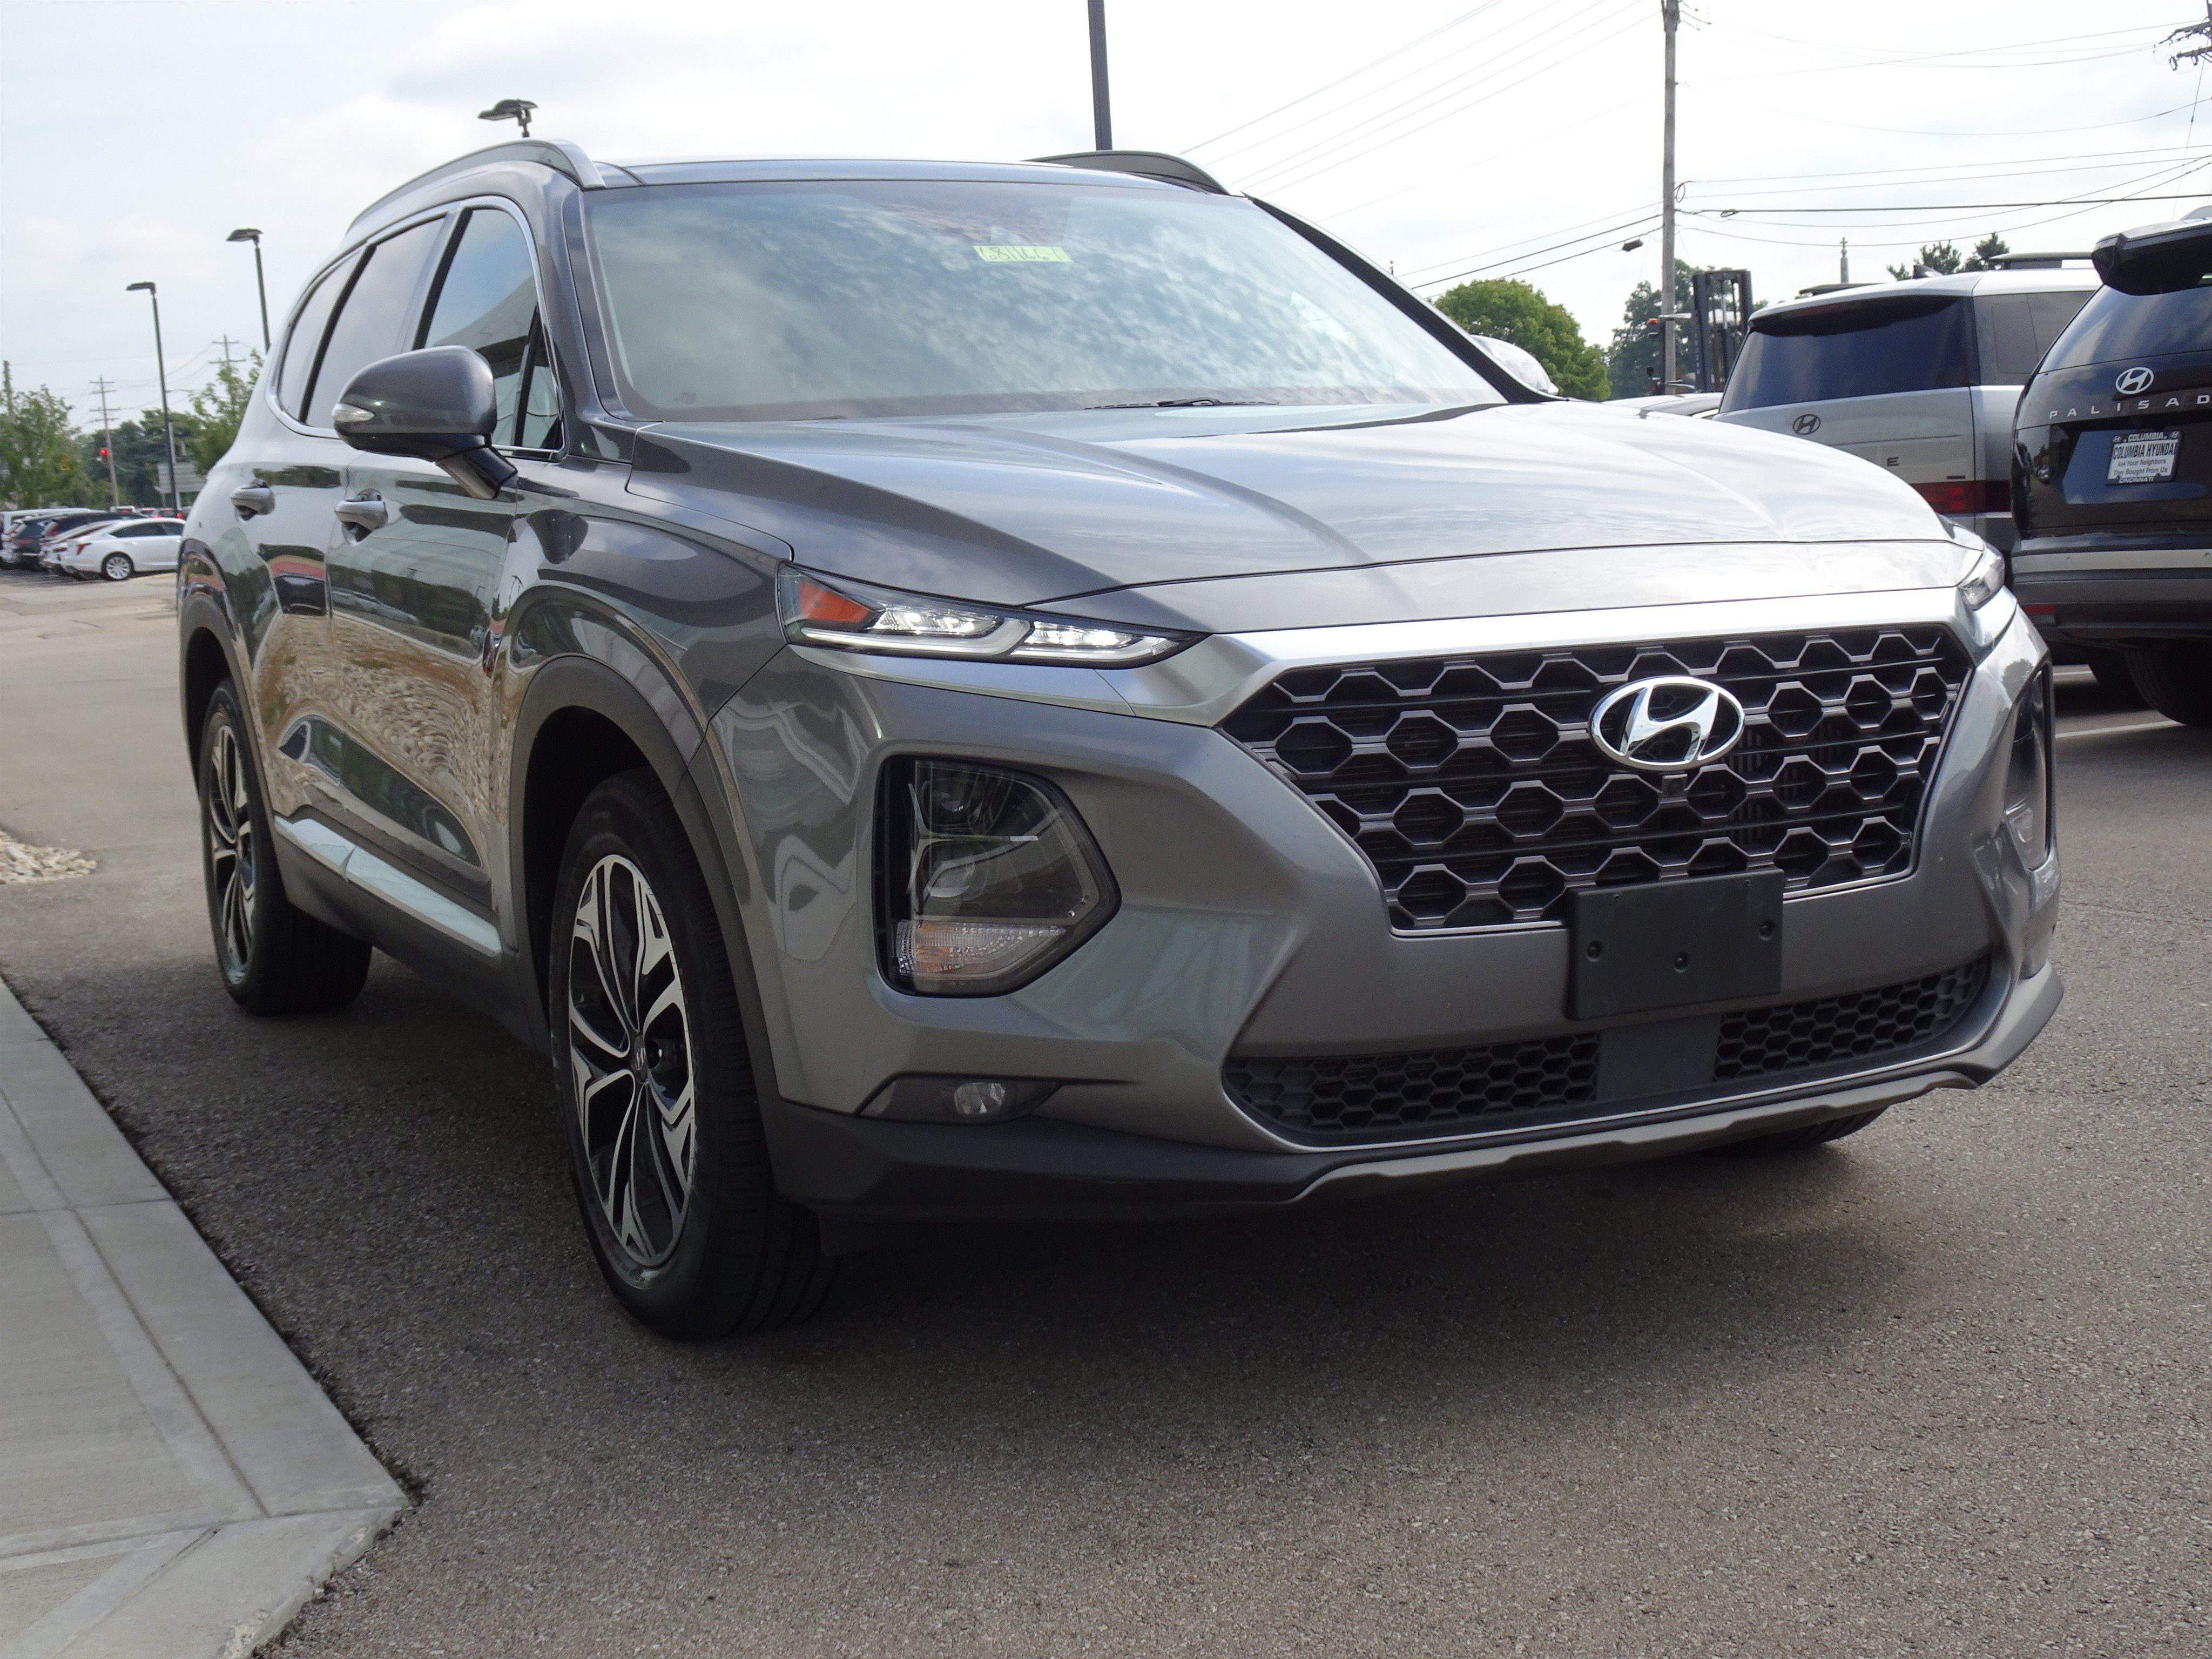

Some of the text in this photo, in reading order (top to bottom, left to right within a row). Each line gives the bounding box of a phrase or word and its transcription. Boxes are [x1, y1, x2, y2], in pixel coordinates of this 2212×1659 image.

[2049, 395, 2210, 419] PALISAD
[2128, 432, 2164, 442] COLUMBIA
[2113, 444, 2144, 459] COLUMBIA
